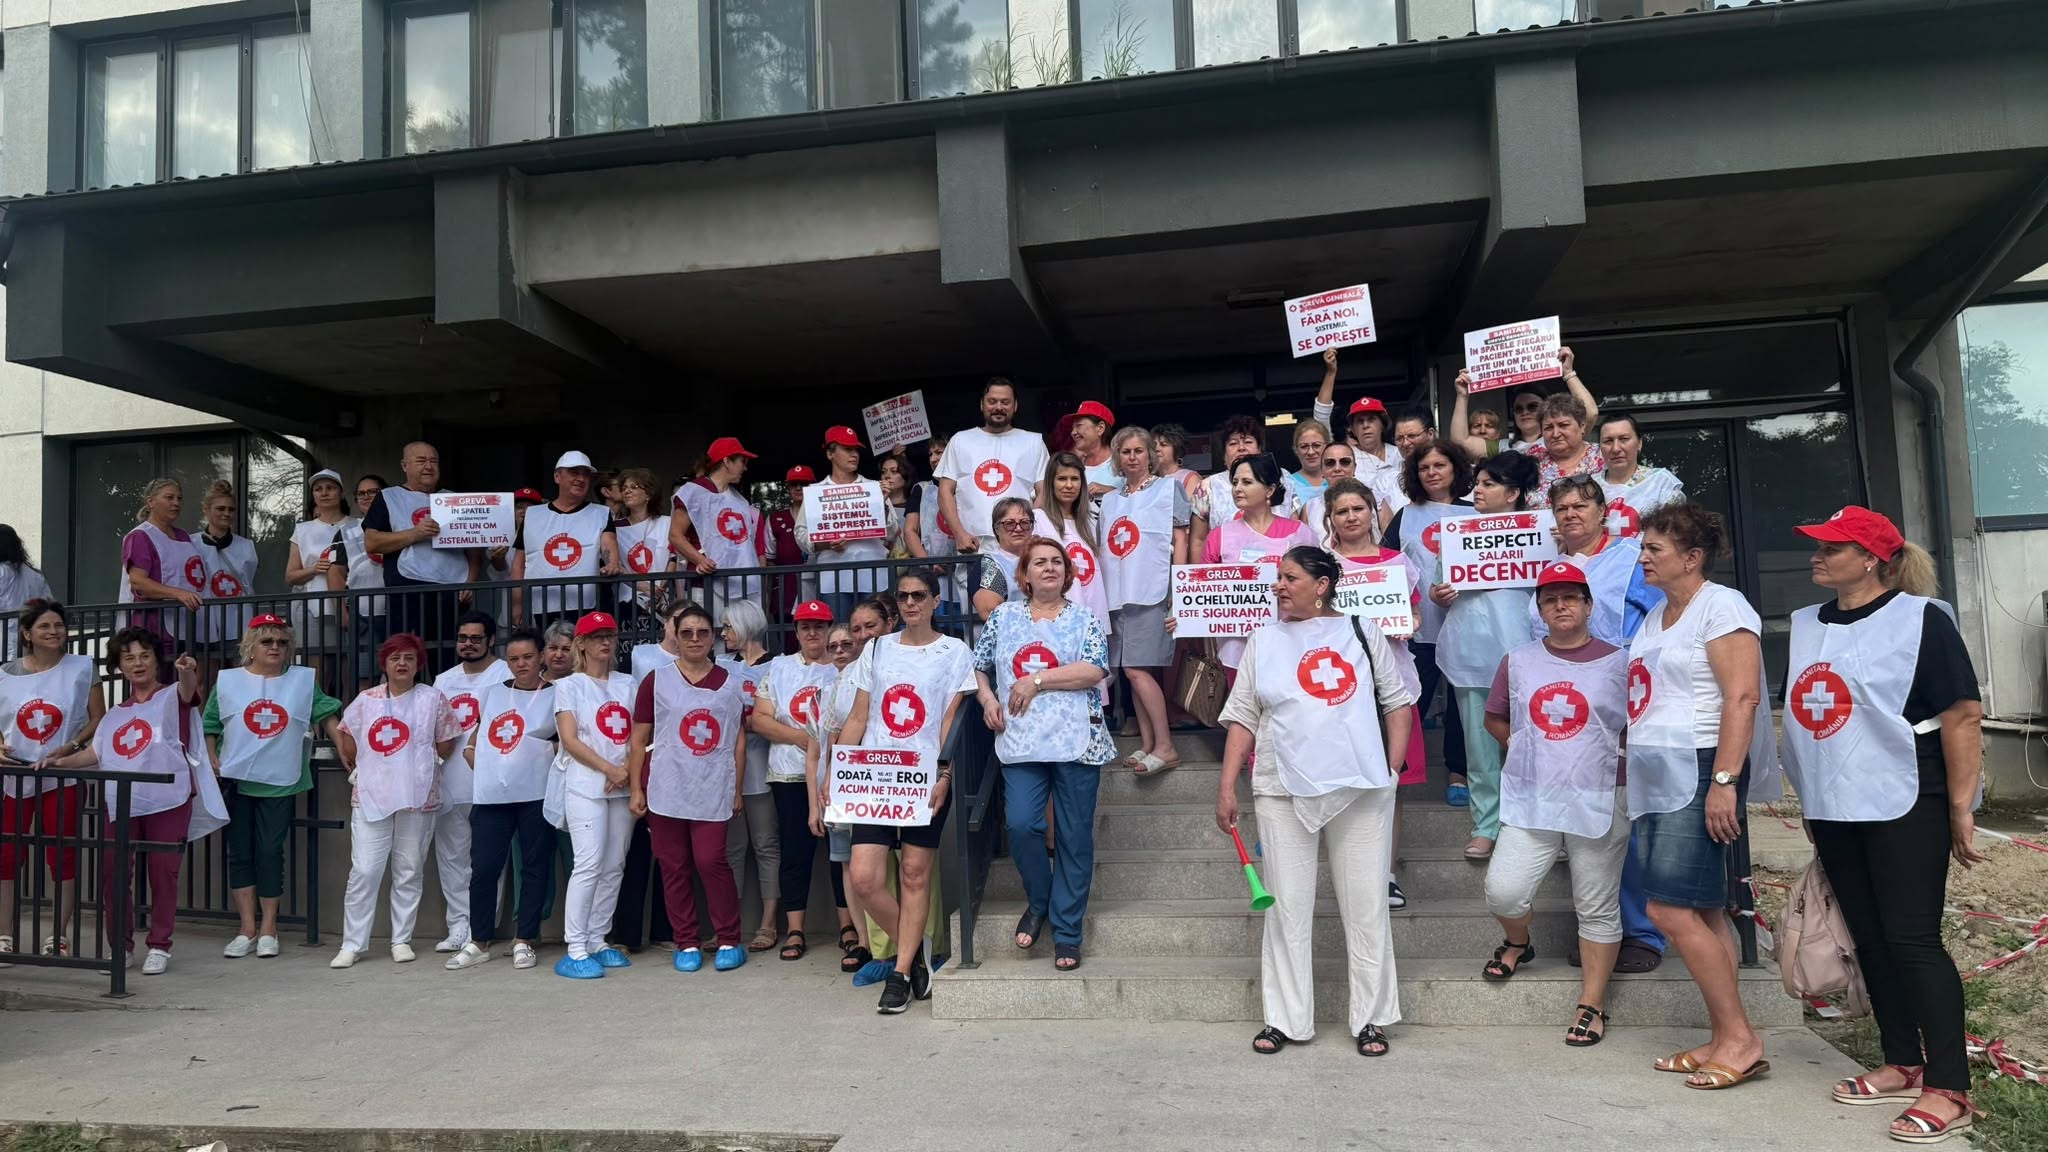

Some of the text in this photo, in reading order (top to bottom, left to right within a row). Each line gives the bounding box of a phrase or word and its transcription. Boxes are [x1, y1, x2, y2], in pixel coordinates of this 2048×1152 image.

[1300, 307, 1359, 327] FĂRĂ NOI,
[1315, 321, 1347, 333] SISTEMUL
[1297, 327, 1370, 351] SE OPREȘTE
[1480, 342, 1515, 354] SPATELE
[1480, 344, 1545, 362] PACIENT SALVAT
[1471, 351, 1557, 373] ESTE UN OM PE CARE
[1478, 367, 1518, 380] SISTEMUL
[827, 487, 859, 496] SANITAS
[459, 496, 487, 505] GREVĂ
[822, 501, 869, 511] FĂRĂ NOI
[451, 506, 460, 514] ÎN
[822, 510, 872, 521] SISTEMUL
[449, 522, 468, 530] ESTE
[469, 522, 481, 530] UN
[817, 519, 878, 531] SE OPREȘTE
[1478, 515, 1517, 529] GREVĂ
[439, 536, 479, 545] SISTEMUL
[490, 533, 509, 544] UITĂ
[1462, 532, 1542, 550] RESPECT!
[1478, 549, 1523, 560] SALARII
[1206, 567, 1242, 579] GREVĂ
[1176, 582, 1269, 593] SĂNĂTATEA NU ESTE
[1183, 595, 1192, 605] O
[1338, 593, 1406, 608] UN COST,
[1179, 607, 1271, 620] ESTE SIGURANȚA
[1209, 623, 1236, 633] UNEI
[1798, 663, 1827, 684] SANITAS
[1540, 682, 1570, 693] SANITAS
[866, 751, 902, 764] GREVĂ
[837, 768, 872, 781] ODATĂ
[897, 771, 928, 784] EROI
[838, 784, 927, 800] ACUM NE TRATAȚI
[845, 800, 916, 820] POVARĂ
